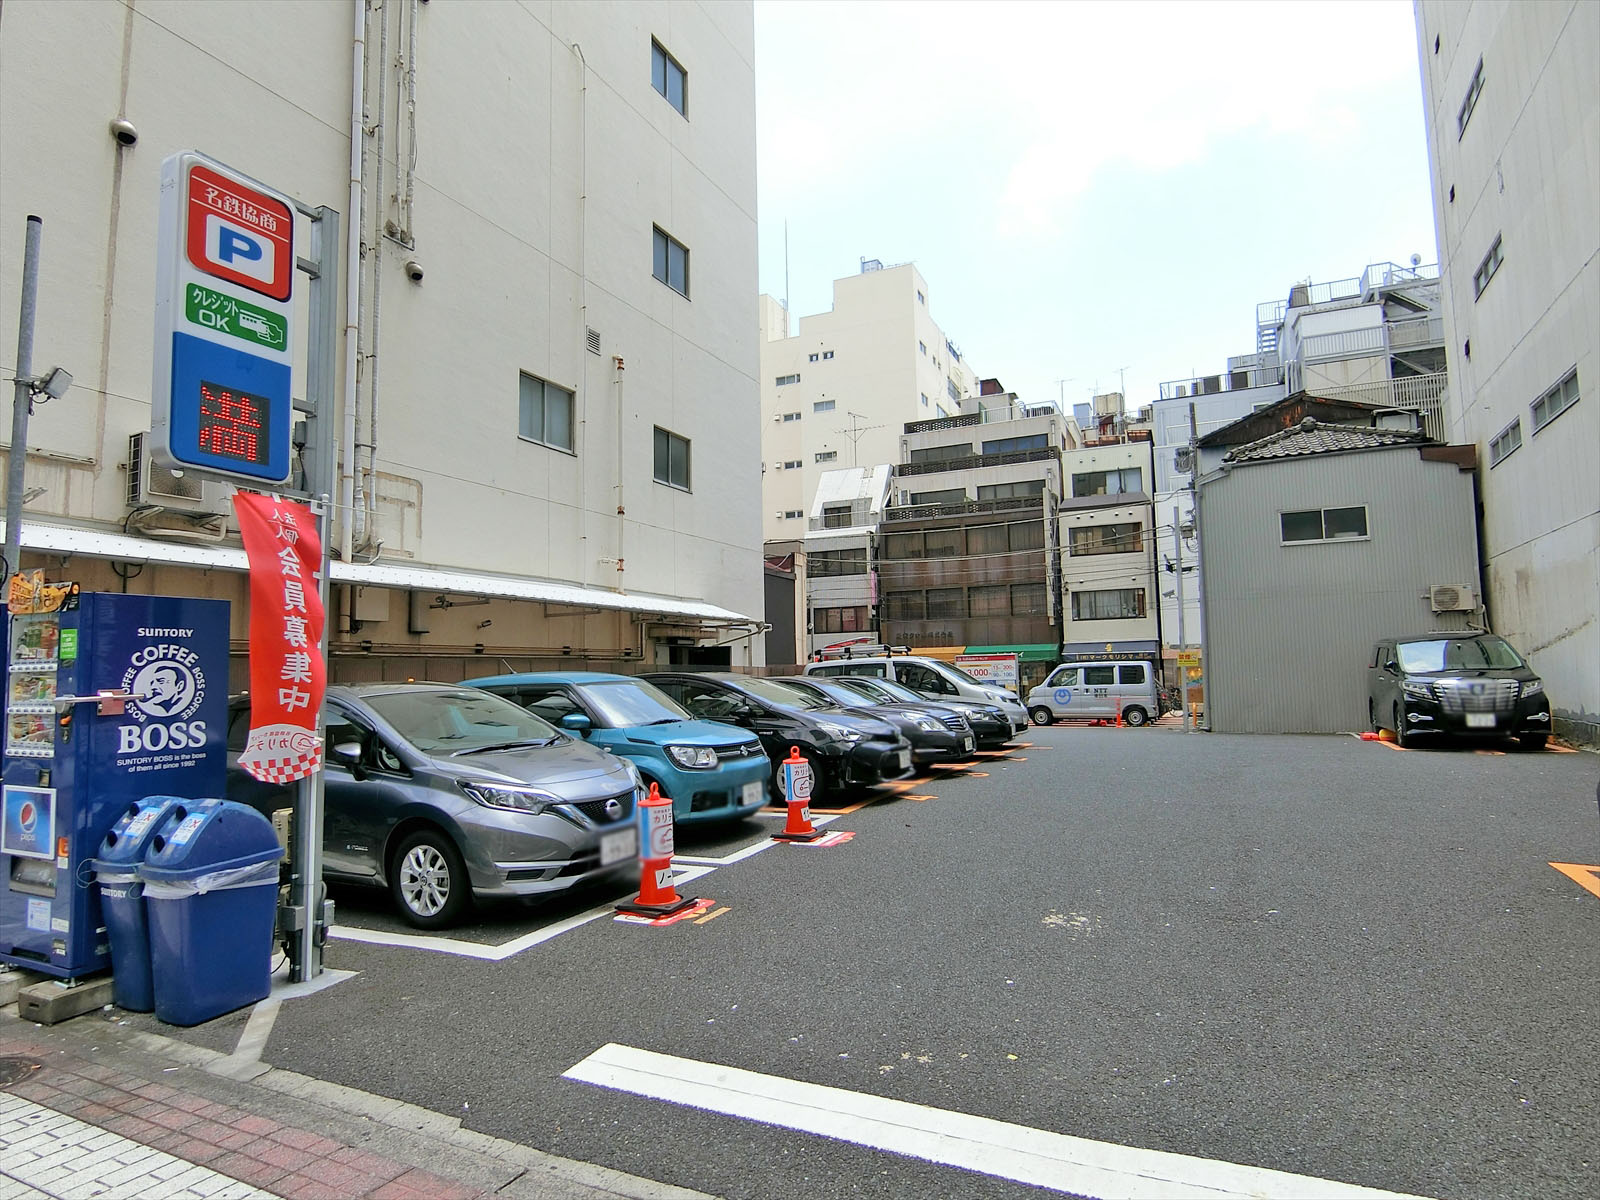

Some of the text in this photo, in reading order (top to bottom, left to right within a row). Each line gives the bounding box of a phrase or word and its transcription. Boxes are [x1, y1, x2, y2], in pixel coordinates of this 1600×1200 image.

[204, 187, 277, 232] 名鉄協商
[219, 225, 262, 264] P
[193, 288, 239, 316] クレジット
[199, 309, 230, 333] OK
[200, 386, 261, 461] 満
[137, 627, 194, 638] SUNTORY
[131, 644, 199, 667] COFFEE
[121, 666, 147, 723] OFFEE BOSS
[181, 666, 206, 720] BOSS COFFEE
[117, 720, 207, 754] BOSS
[117, 757, 152, 766] SUNTORY
[153, 755, 173, 763] BOSS
[100, 887, 127, 898] SUNTORY
